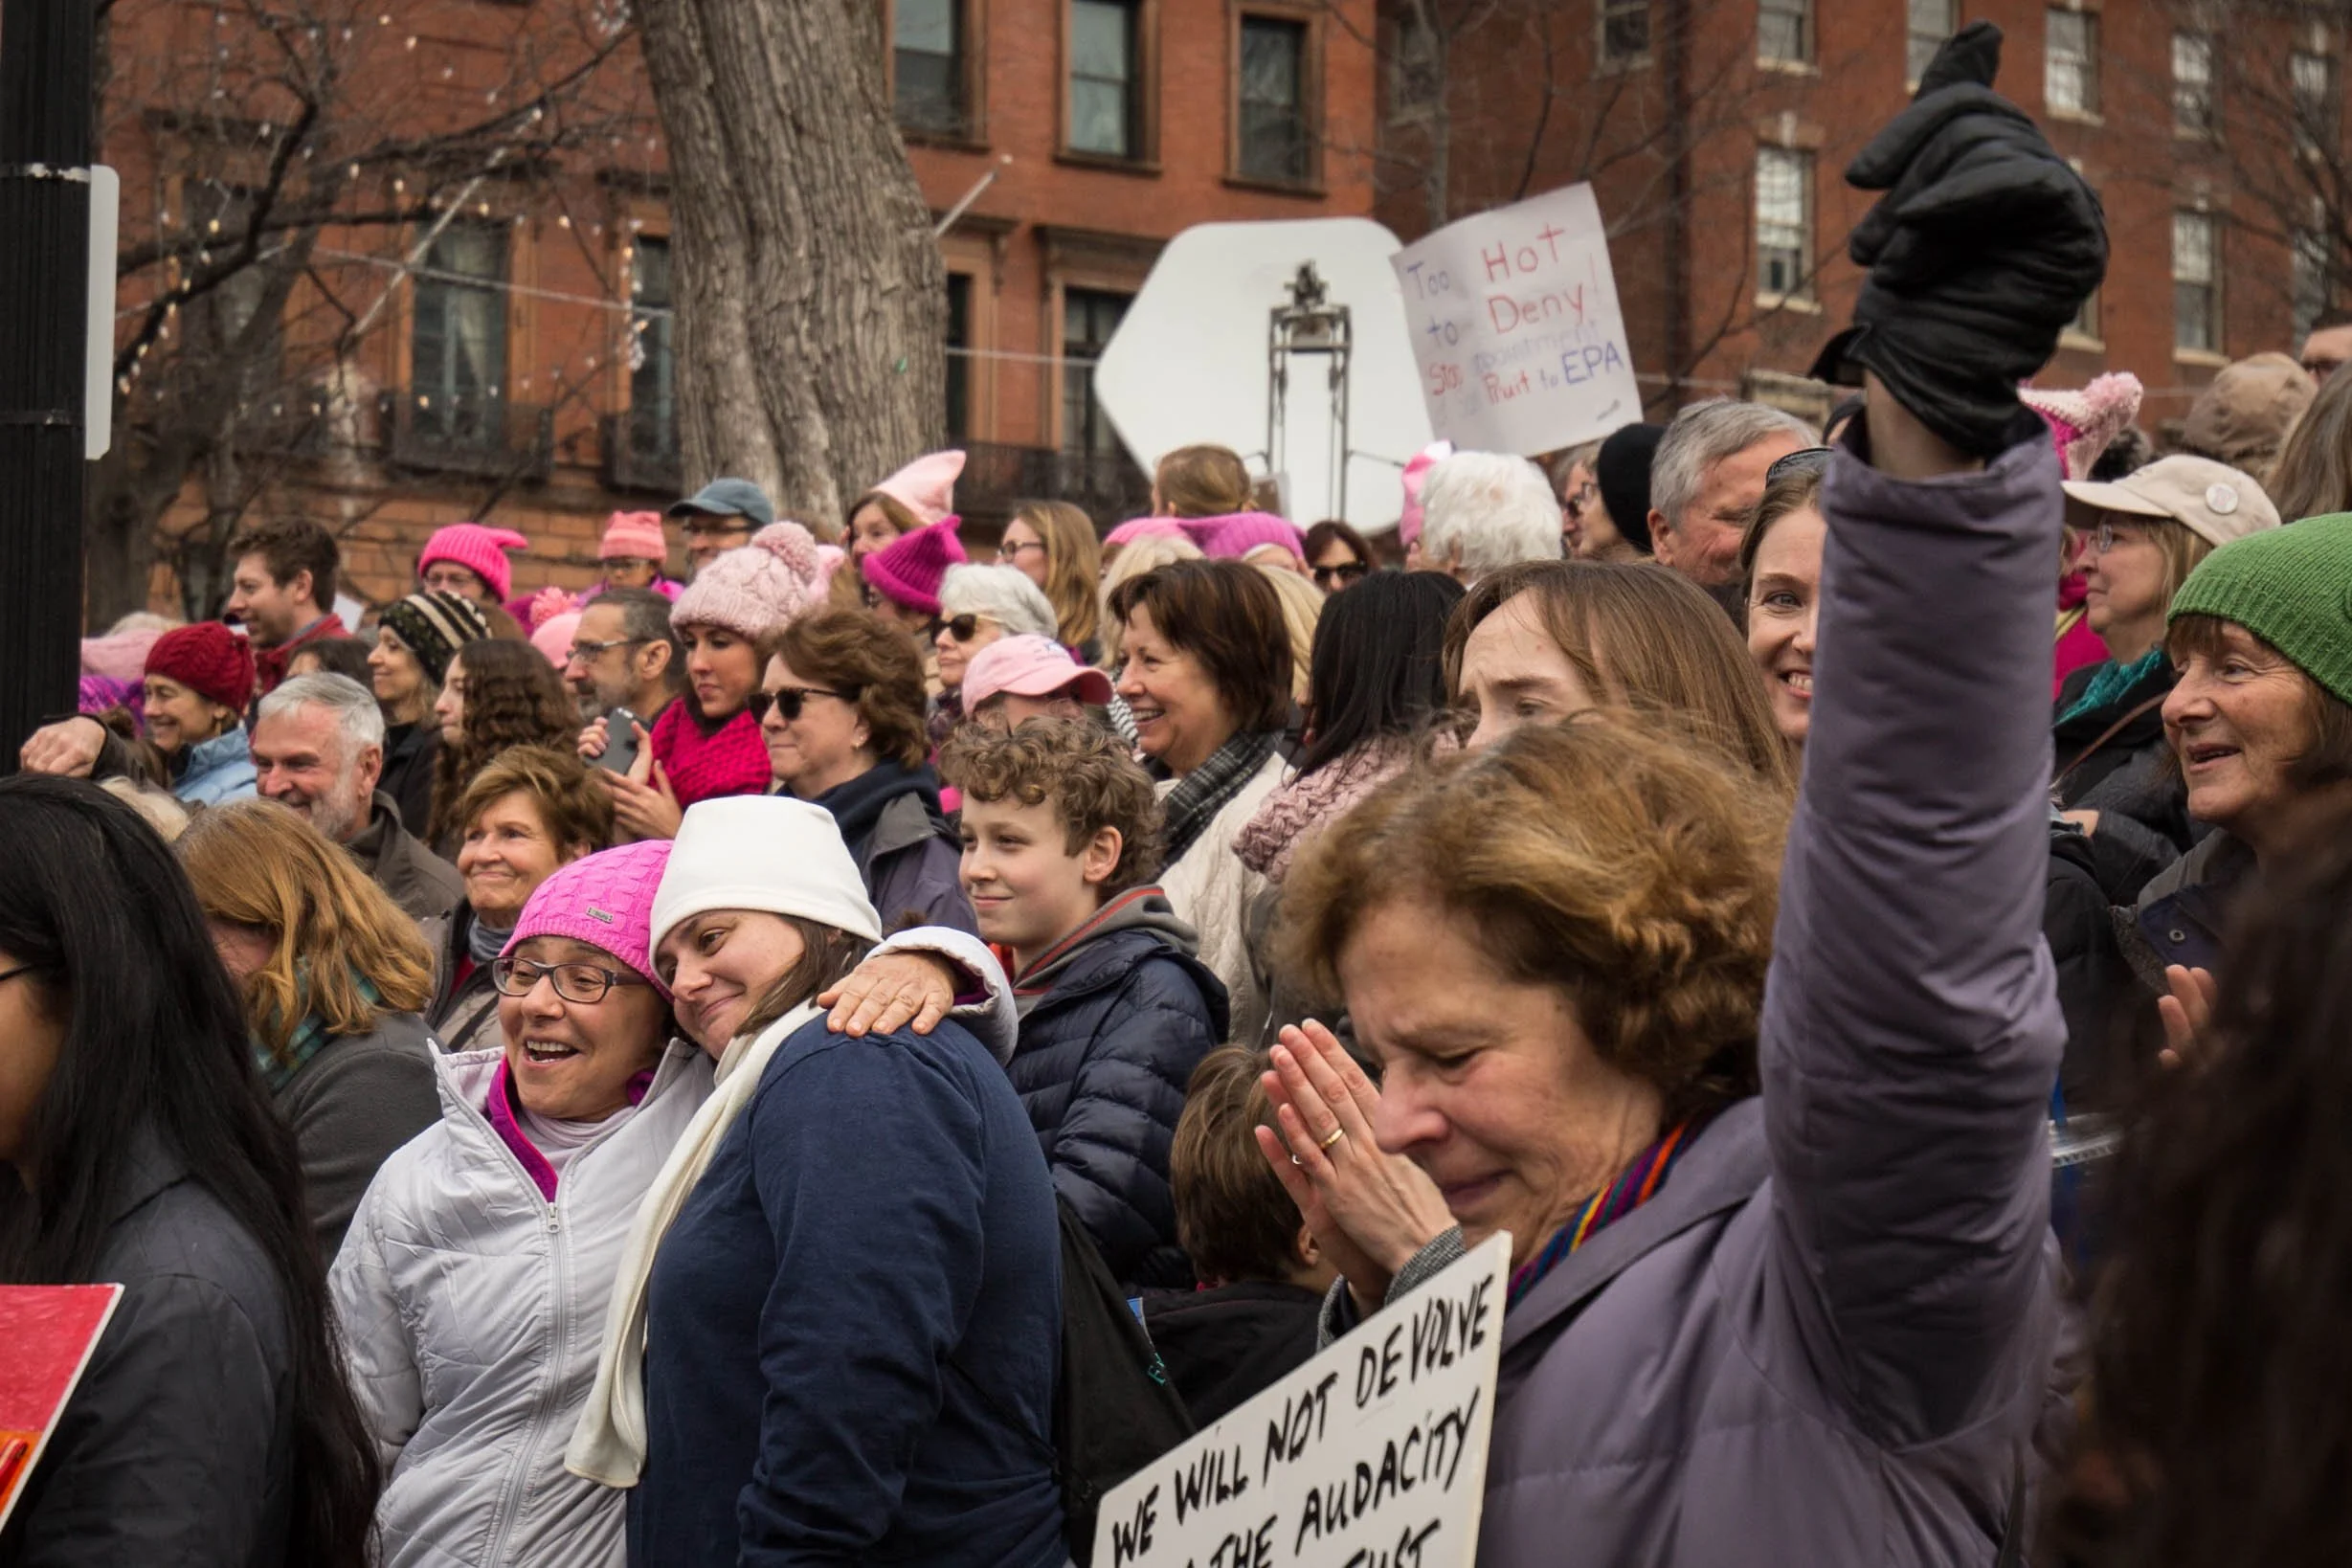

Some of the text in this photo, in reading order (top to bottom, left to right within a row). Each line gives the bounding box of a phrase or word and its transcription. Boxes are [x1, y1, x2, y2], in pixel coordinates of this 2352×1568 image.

[1406, 261, 1450, 300] Too
[1427, 318, 1459, 347] to
[1561, 341, 1624, 385] EPA
[1112, 1273, 1494, 1568] WE WILL NOT DEVOLVE
[1210, 1386, 1481, 1568] THE AUDACITY
